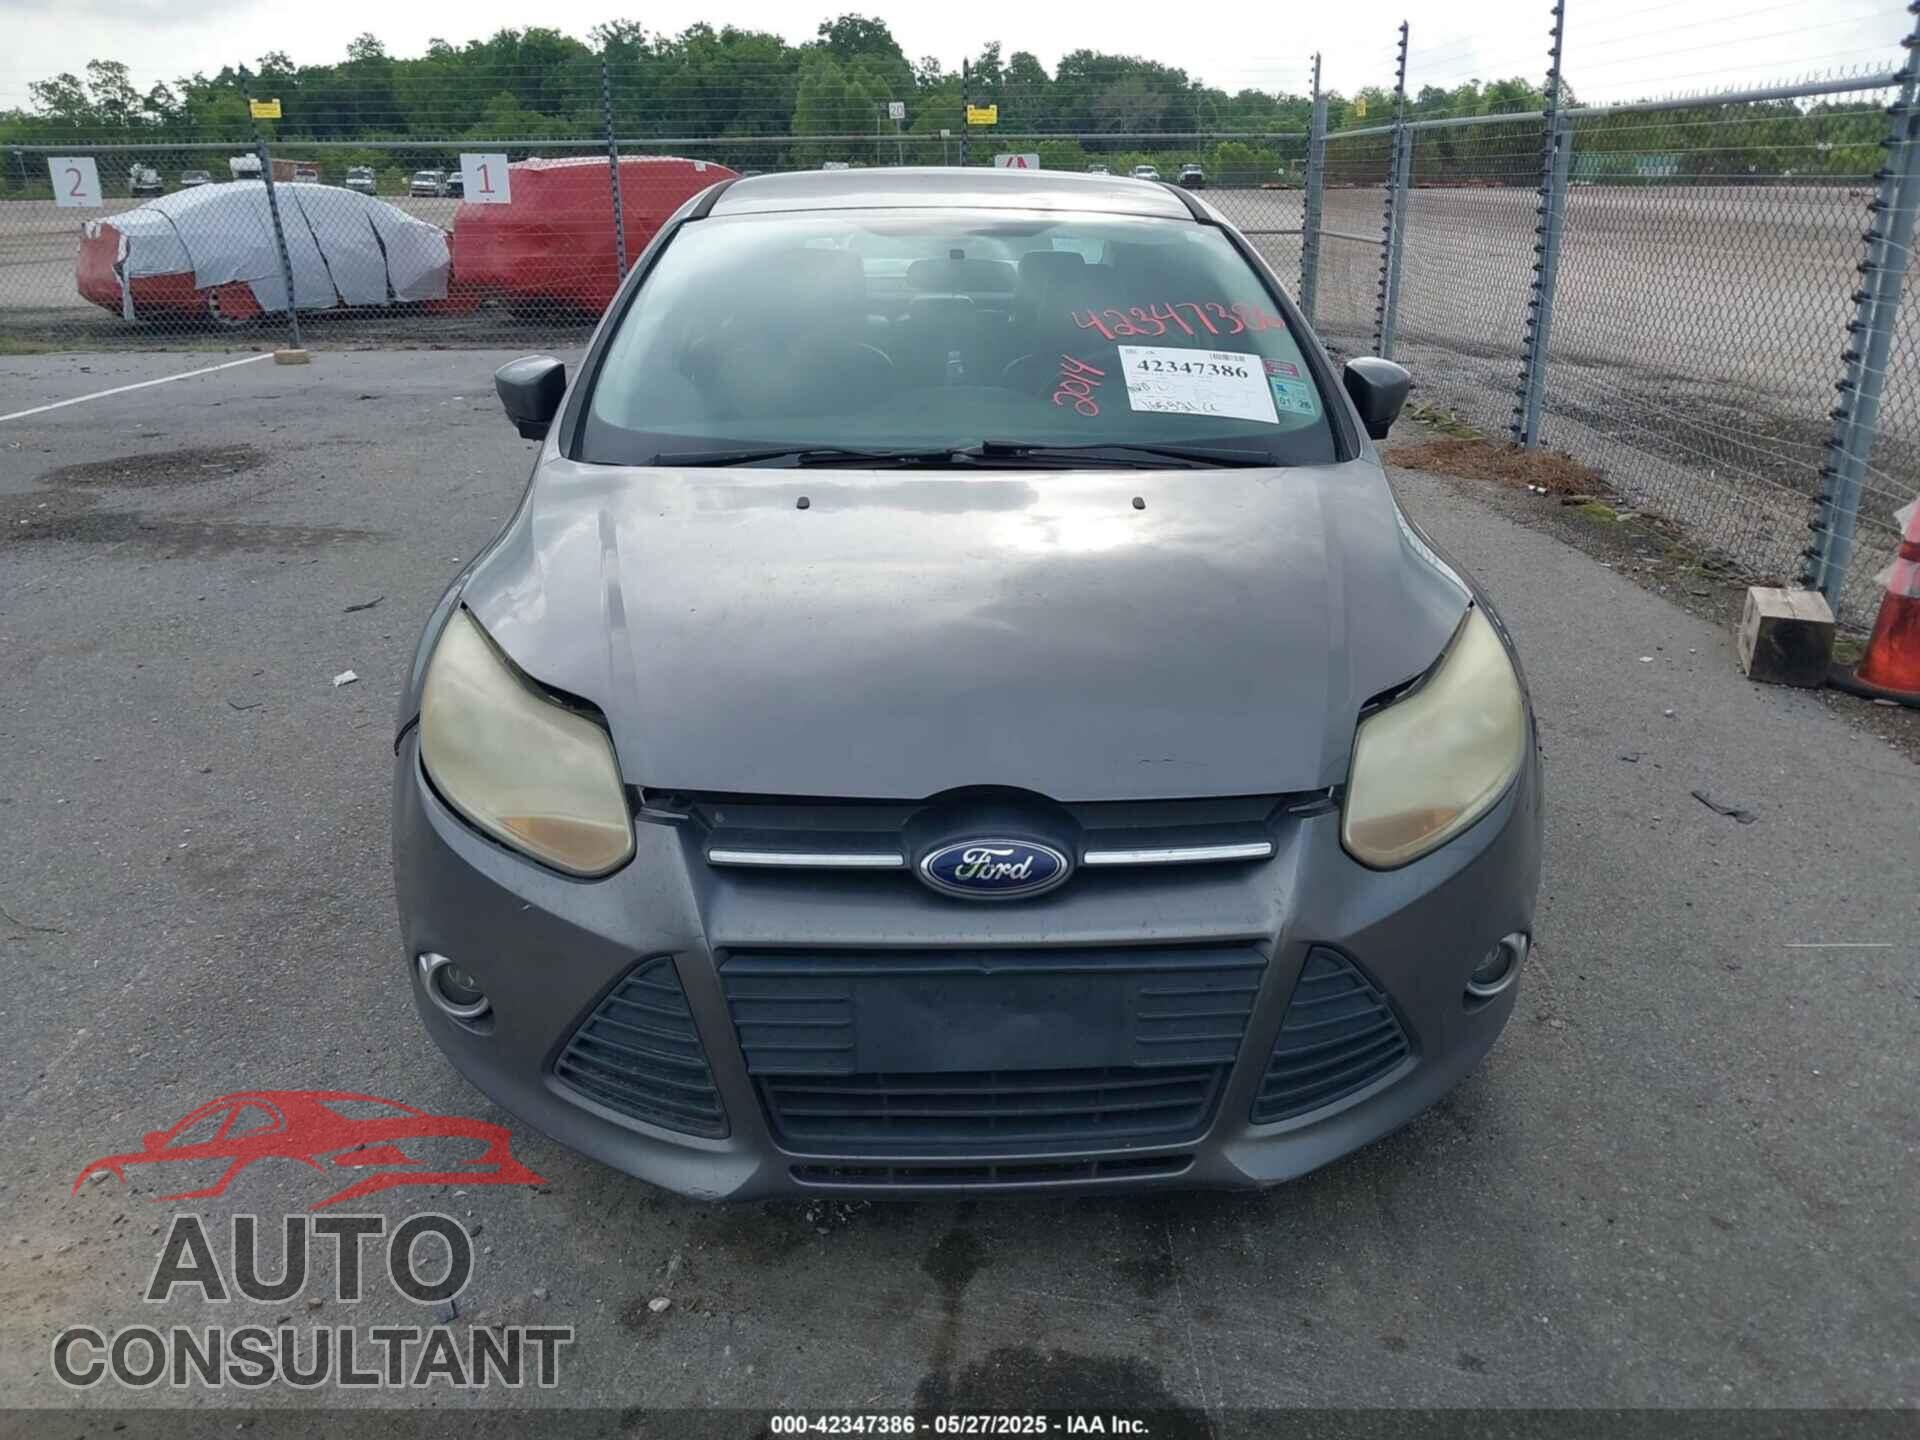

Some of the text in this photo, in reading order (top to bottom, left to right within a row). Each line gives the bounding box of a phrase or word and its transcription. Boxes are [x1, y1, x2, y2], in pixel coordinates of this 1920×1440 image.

[65, 167, 87, 197] 2
[476, 163, 495, 193] 1
[1137, 359, 1249, 379] 42347386
[955, 848, 1034, 880] Ford
